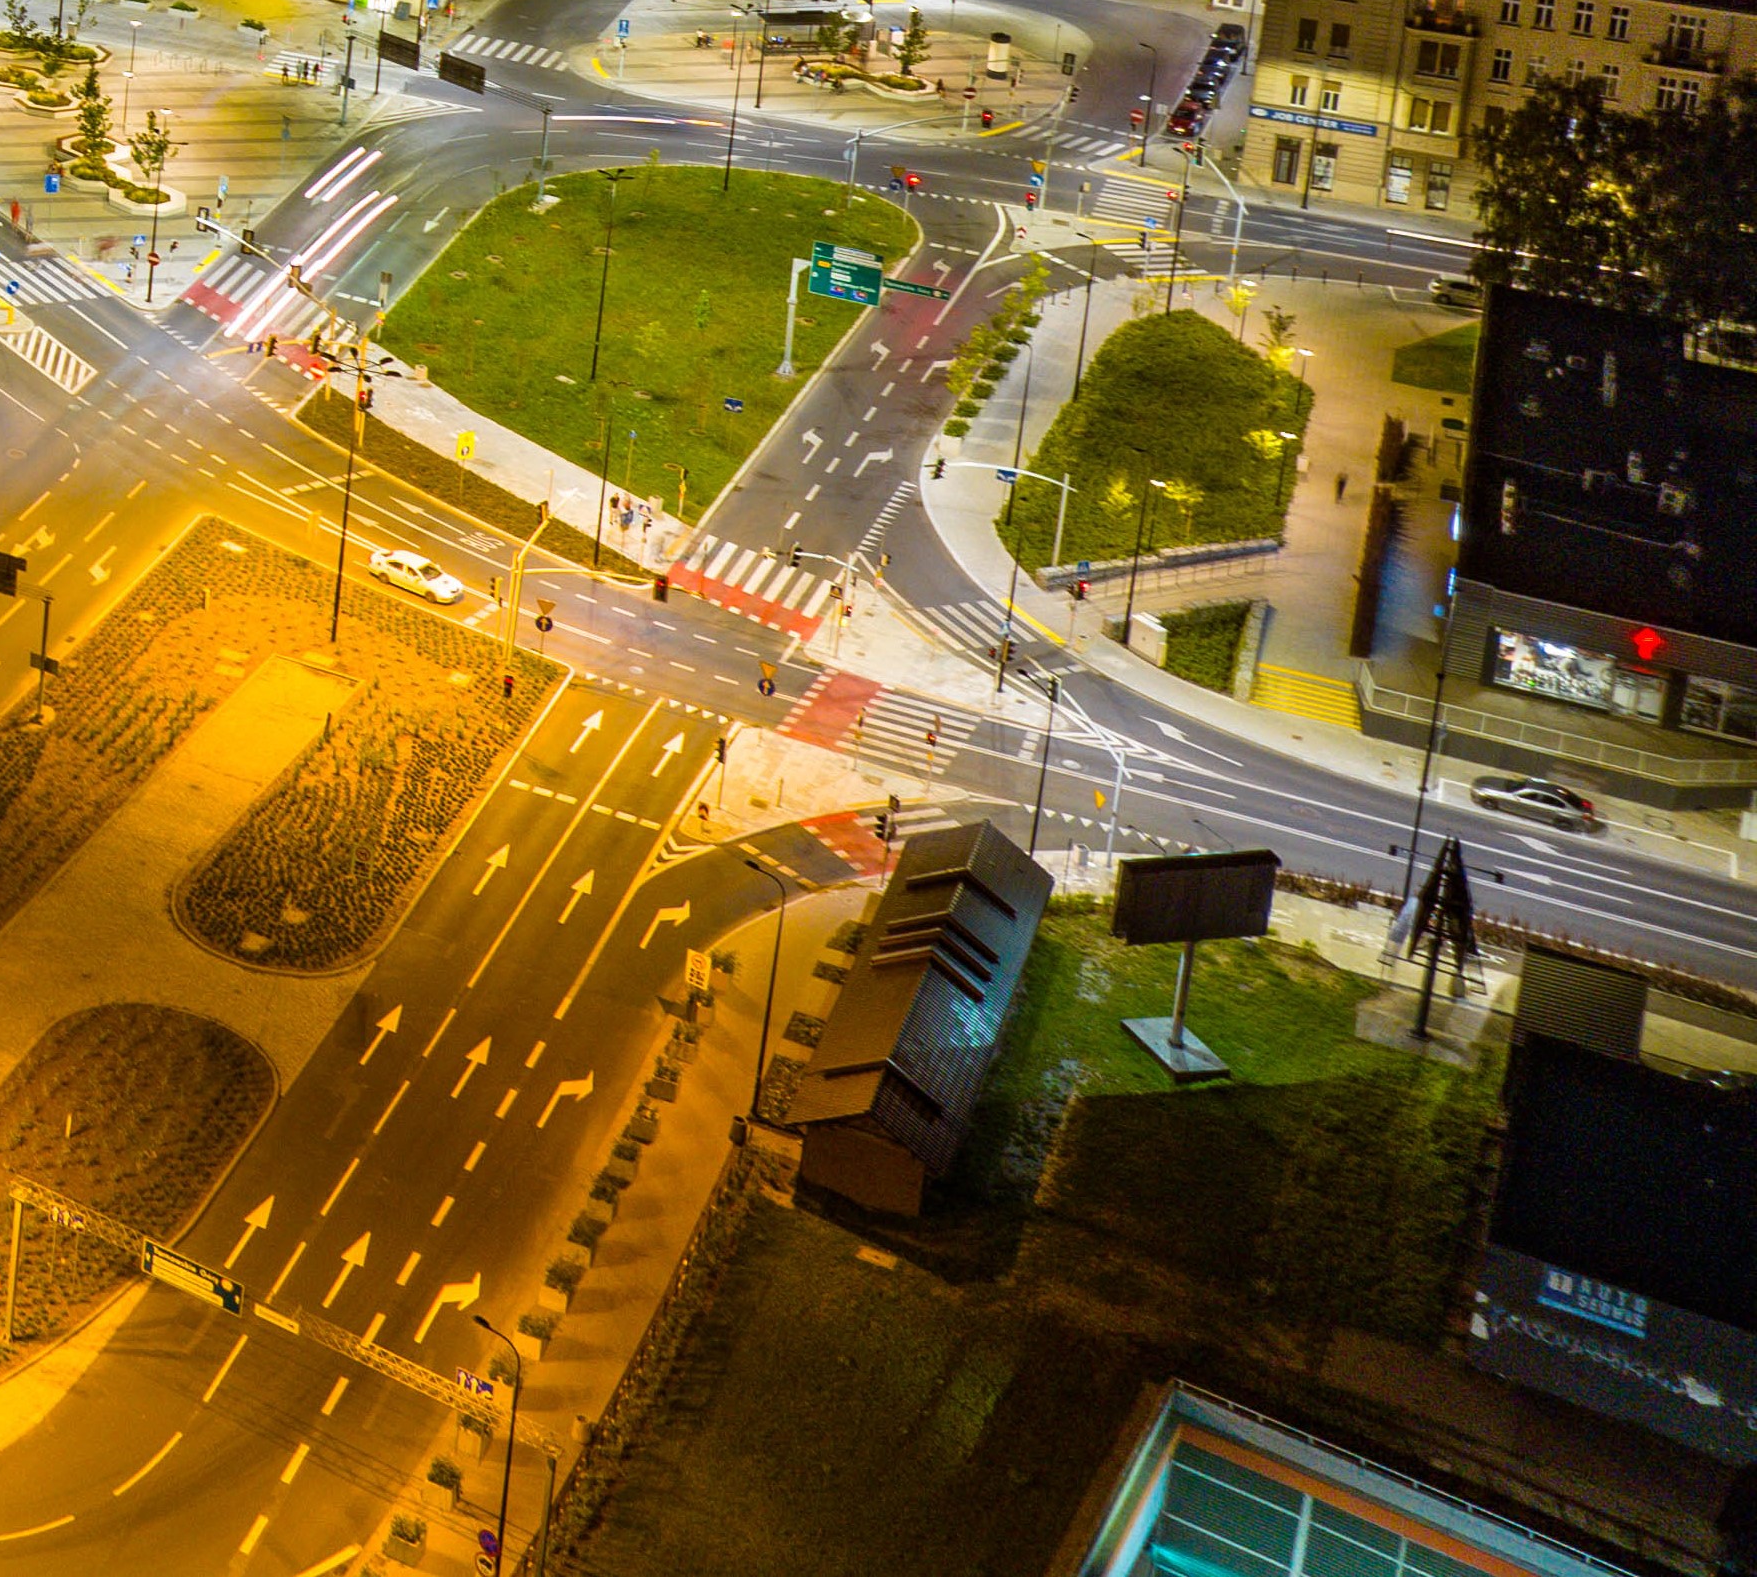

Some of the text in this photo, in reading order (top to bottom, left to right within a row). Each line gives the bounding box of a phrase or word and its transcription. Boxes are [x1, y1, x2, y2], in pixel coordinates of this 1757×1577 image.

[1271, 111, 1294, 122] JOB
[1296, 114, 1339, 129] CENTER
[1581, 1278, 1647, 1313] AUTO
